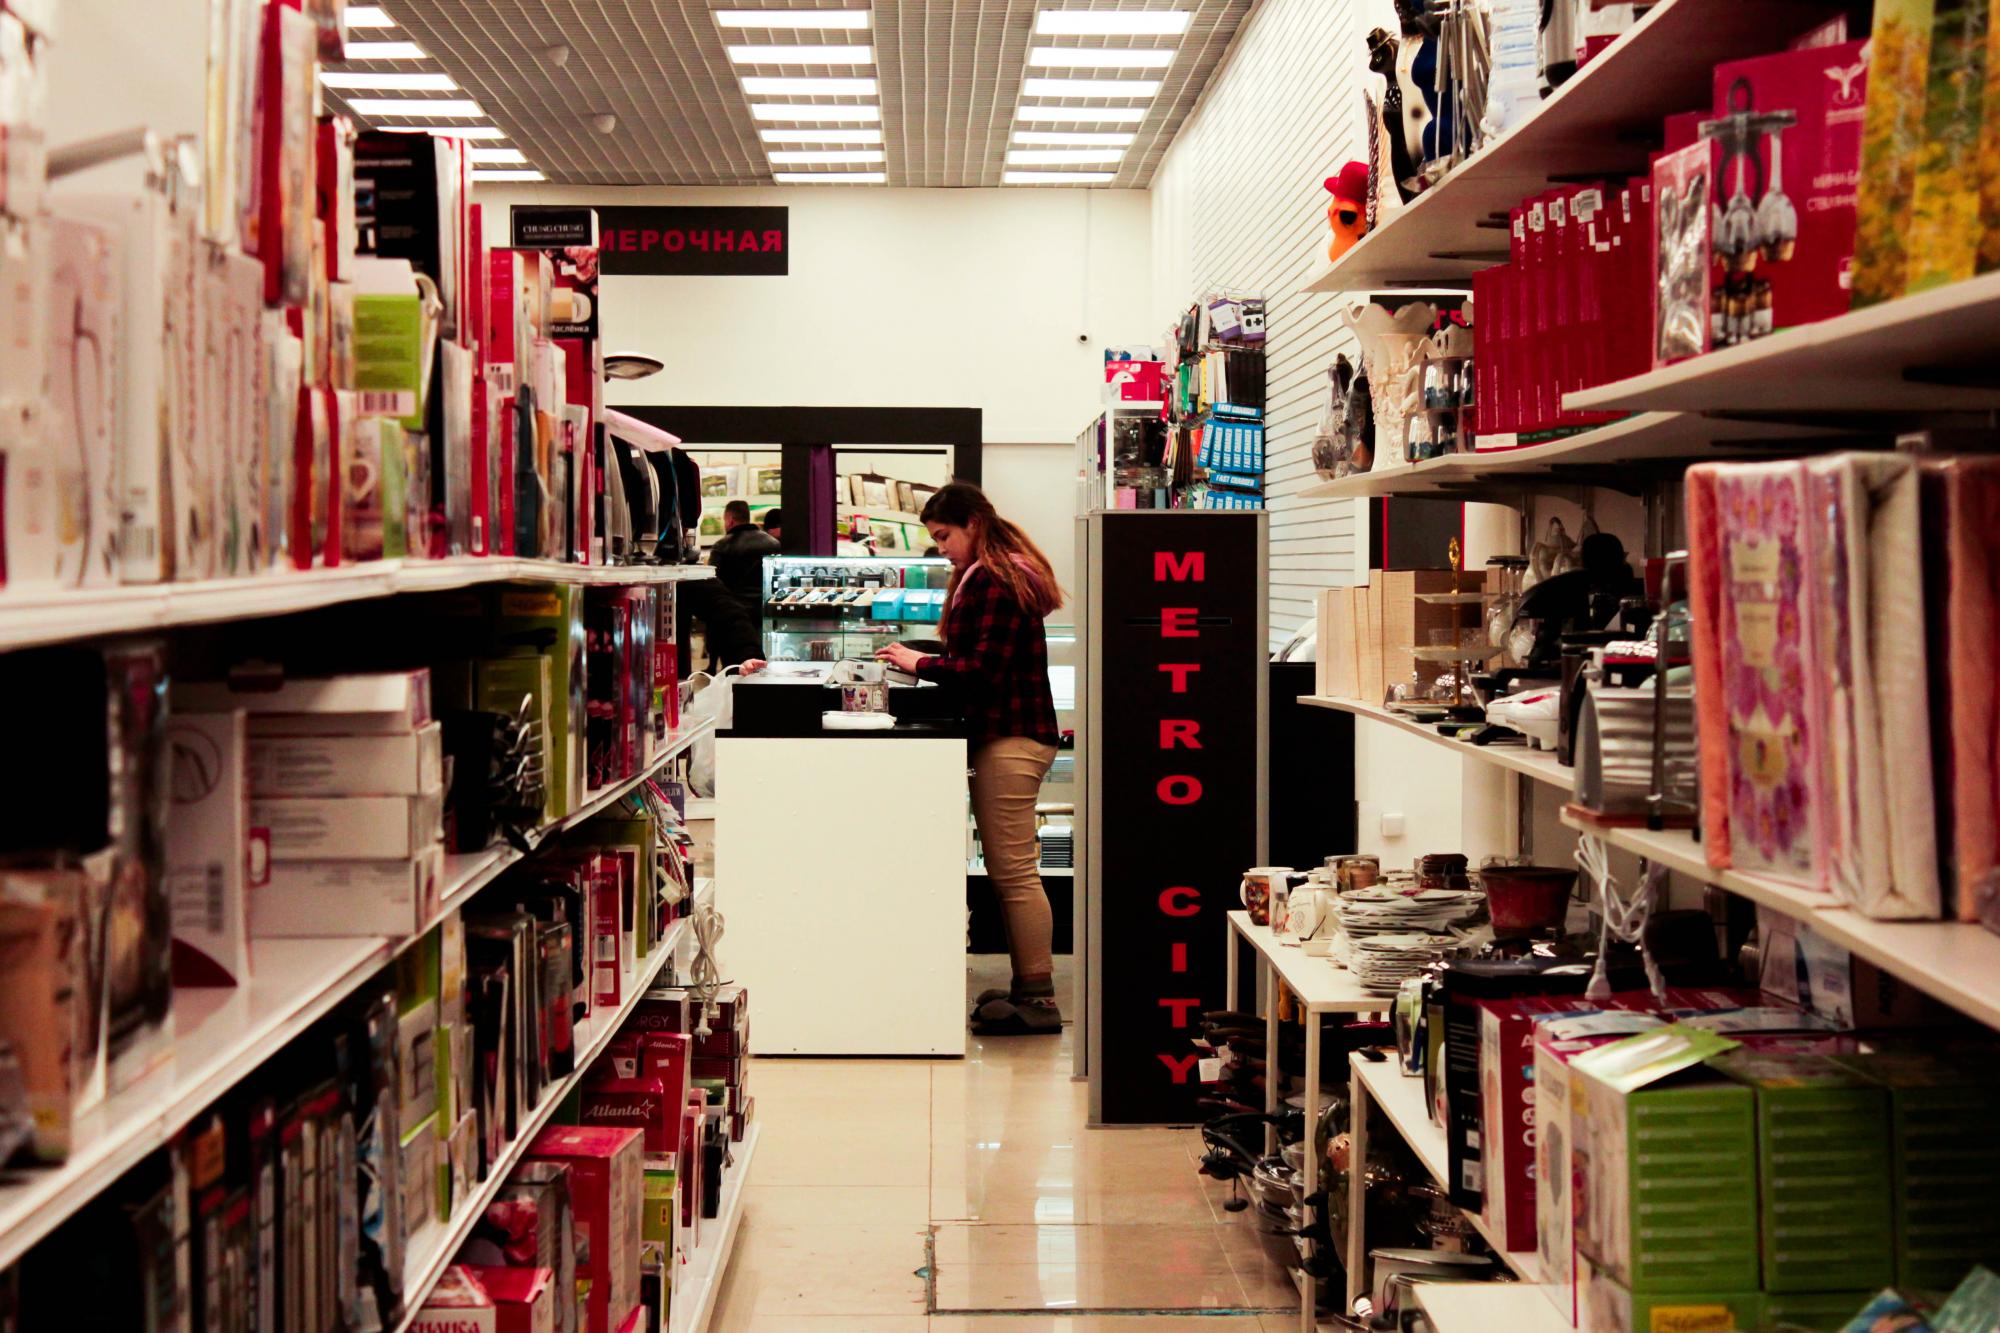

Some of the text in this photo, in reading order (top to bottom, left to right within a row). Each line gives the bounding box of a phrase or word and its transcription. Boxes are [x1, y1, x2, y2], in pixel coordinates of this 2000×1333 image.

[1153, 551, 1205, 1084] METRO CITY
[639, 1016, 669, 1027] RGY
[584, 1104, 641, 1118] Atlanta
